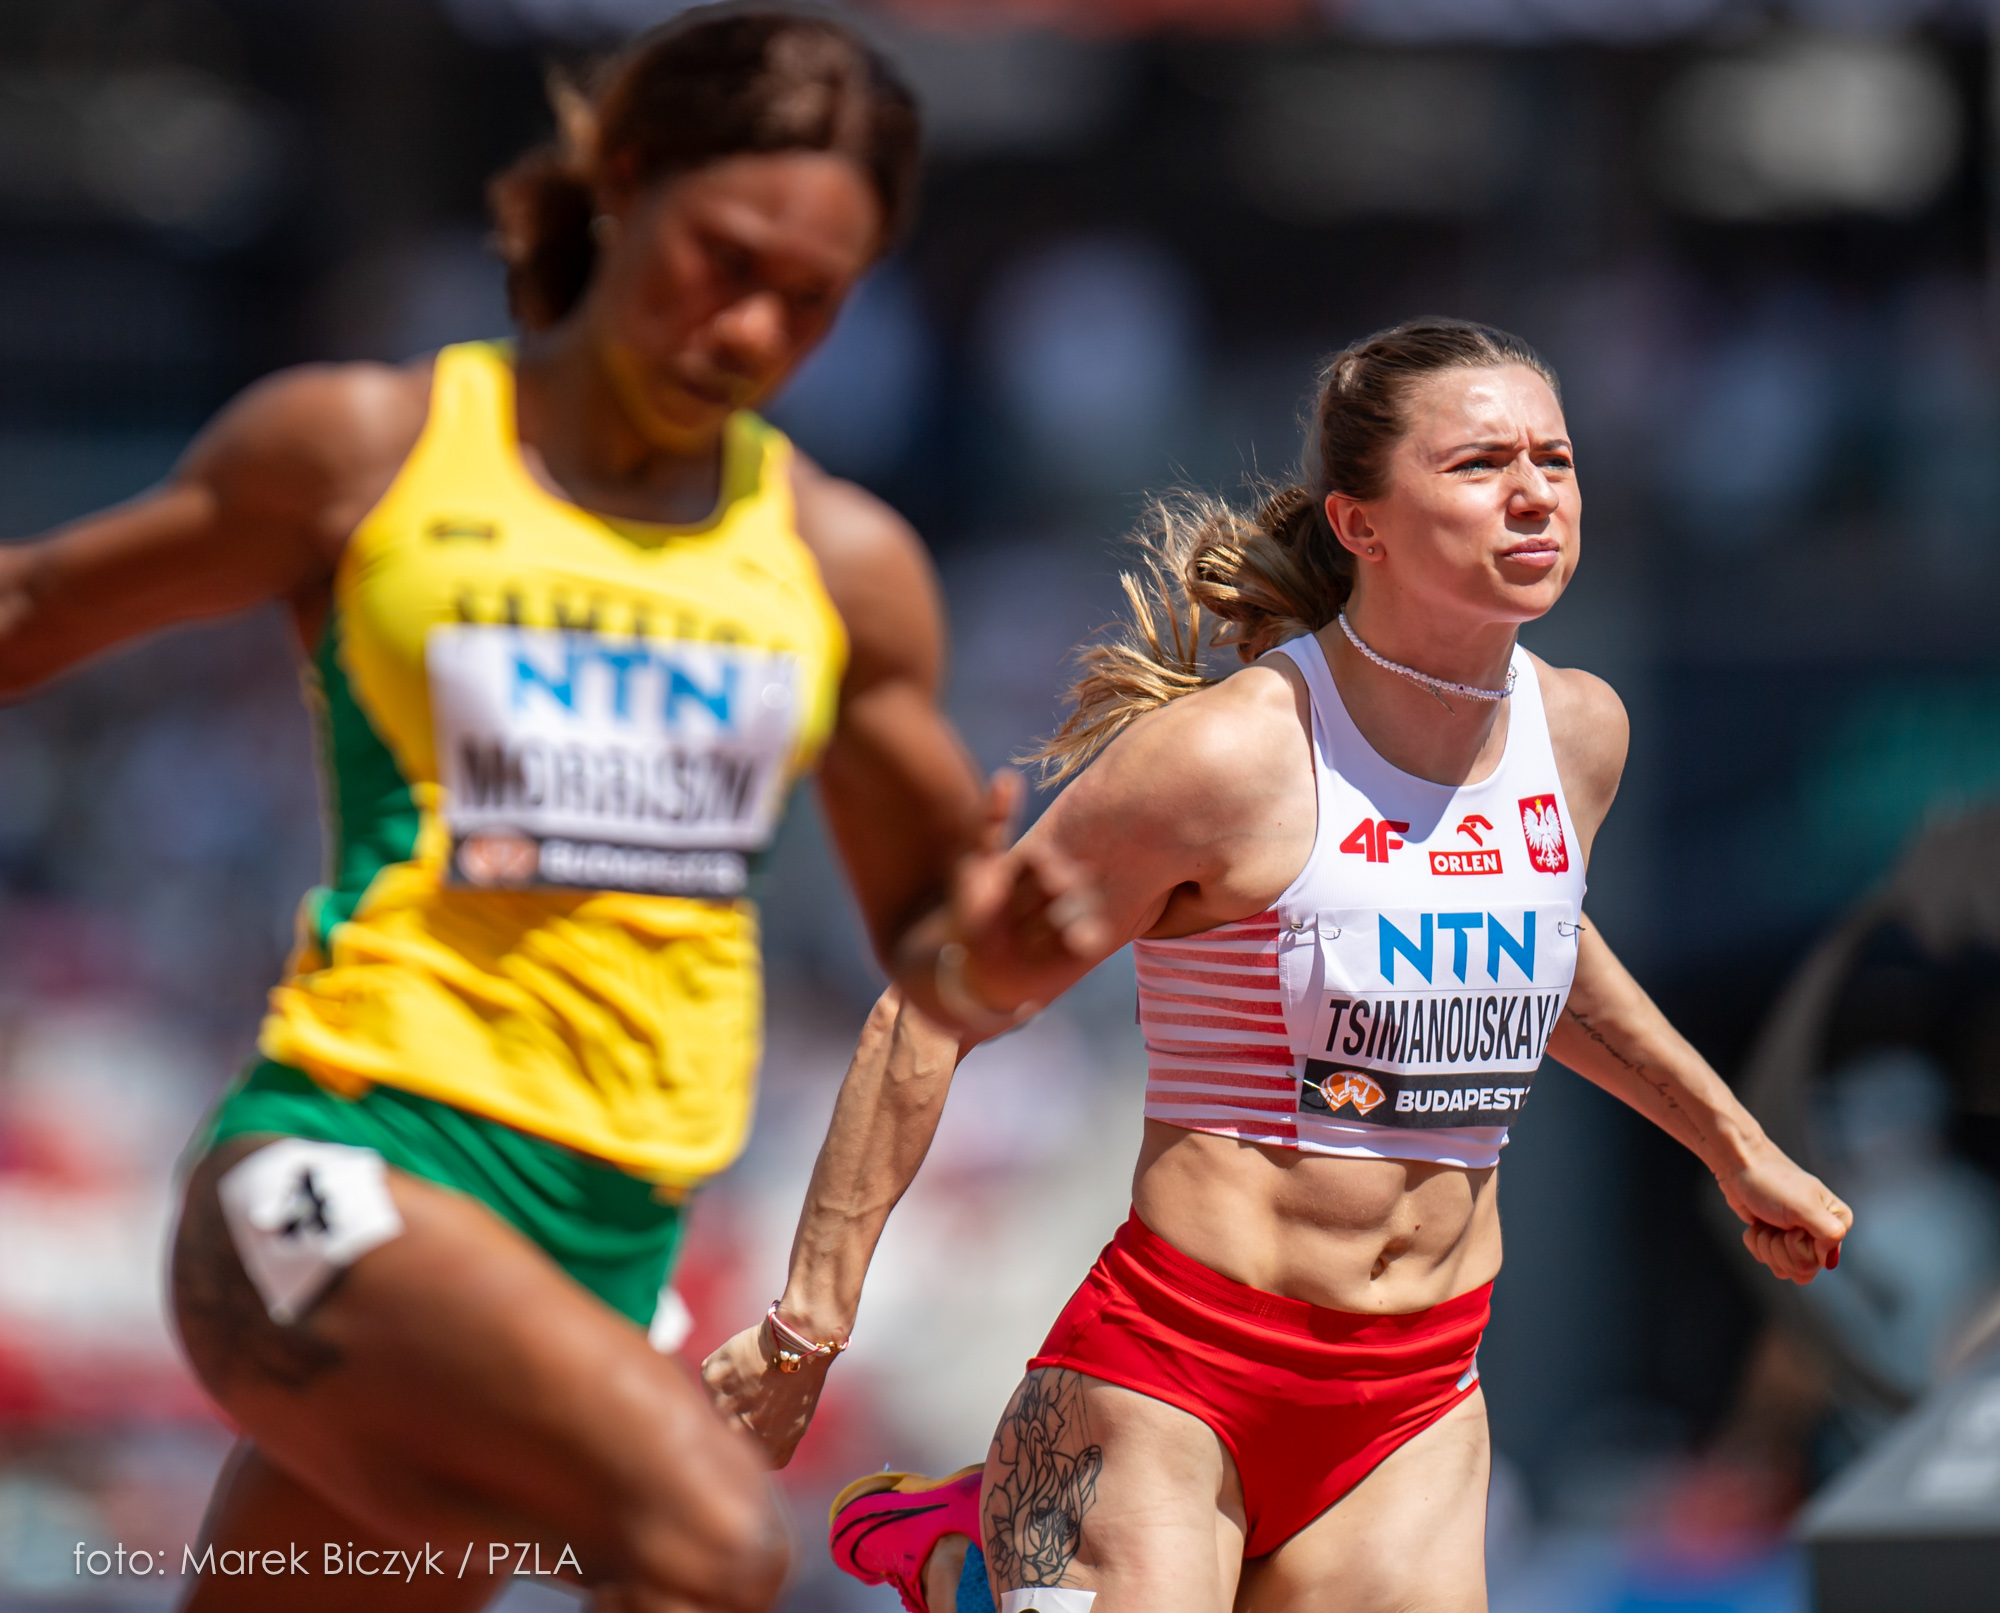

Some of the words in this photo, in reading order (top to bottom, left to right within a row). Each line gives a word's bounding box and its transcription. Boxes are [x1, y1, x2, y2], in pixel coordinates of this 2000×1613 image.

[510, 634, 738, 728] NTN
[1340, 817, 1410, 863] 4F
[1433, 852, 1498, 873] ORLEN
[1378, 911, 1536, 985] NTN
